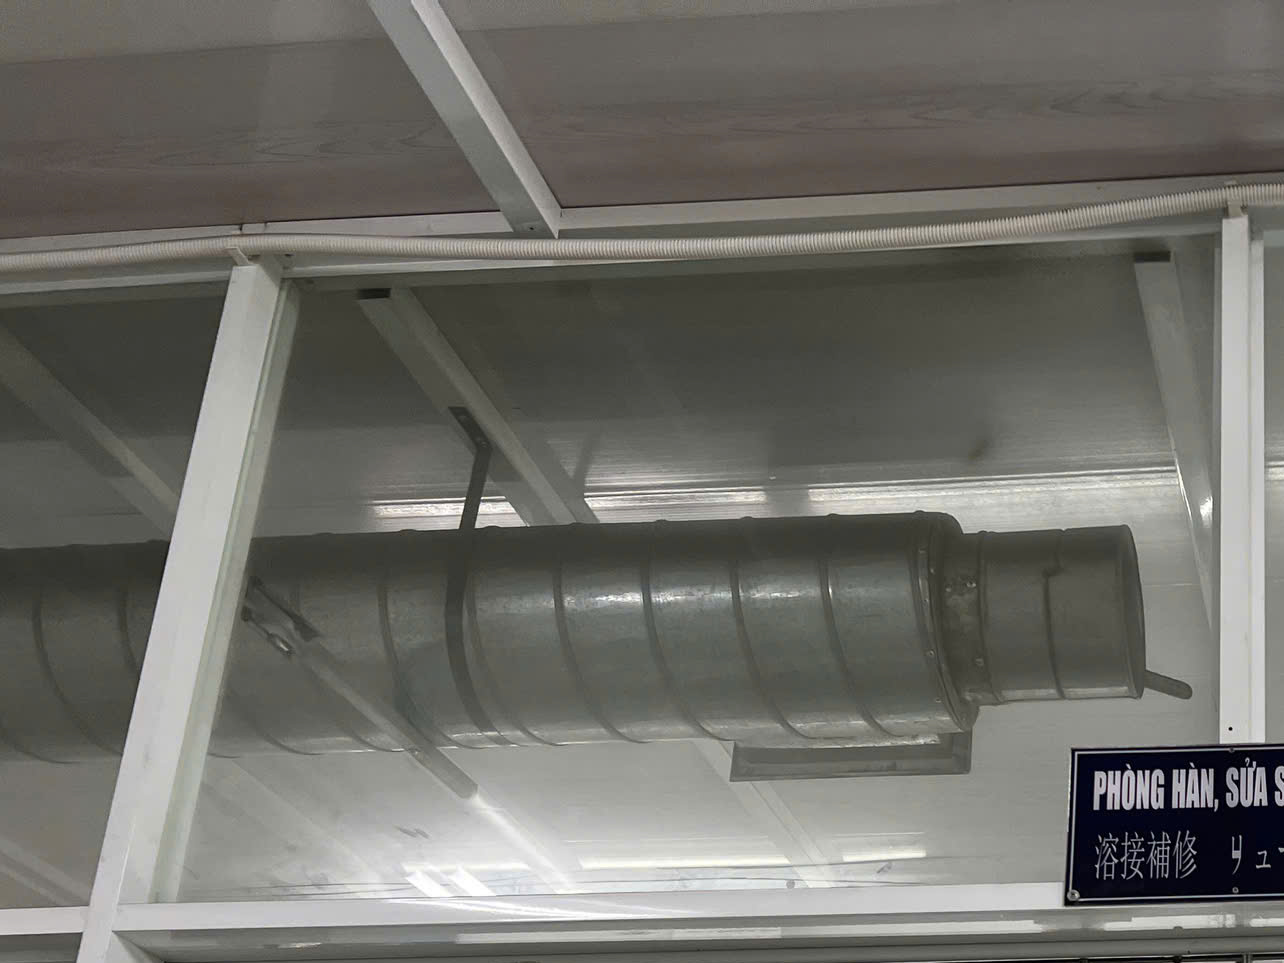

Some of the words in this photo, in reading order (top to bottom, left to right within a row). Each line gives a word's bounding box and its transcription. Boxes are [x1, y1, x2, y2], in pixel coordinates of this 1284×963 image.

[1093, 763, 1165, 811] PHÒNG
[1171, 762, 1219, 812] HÀN,
[1225, 757, 1269, 808] SỬA
[1094, 830, 1198, 881] 溶接補修
